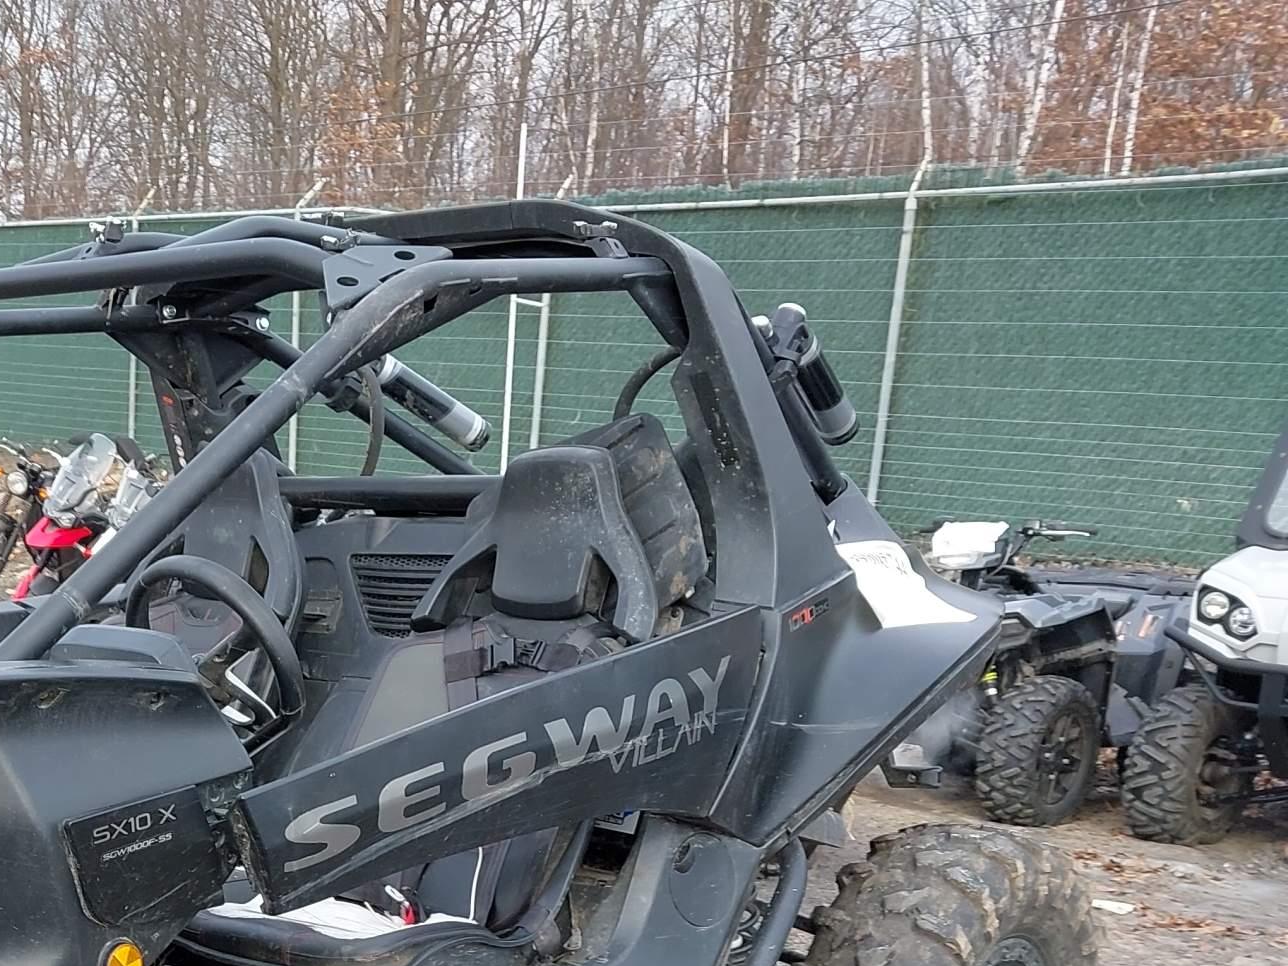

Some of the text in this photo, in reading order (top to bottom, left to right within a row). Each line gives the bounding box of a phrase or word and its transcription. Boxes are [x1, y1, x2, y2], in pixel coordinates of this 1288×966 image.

[284, 655, 732, 873] SEGWAY
[610, 710, 716, 774] VILLAIN
[93, 804, 177, 844] SX10 X
